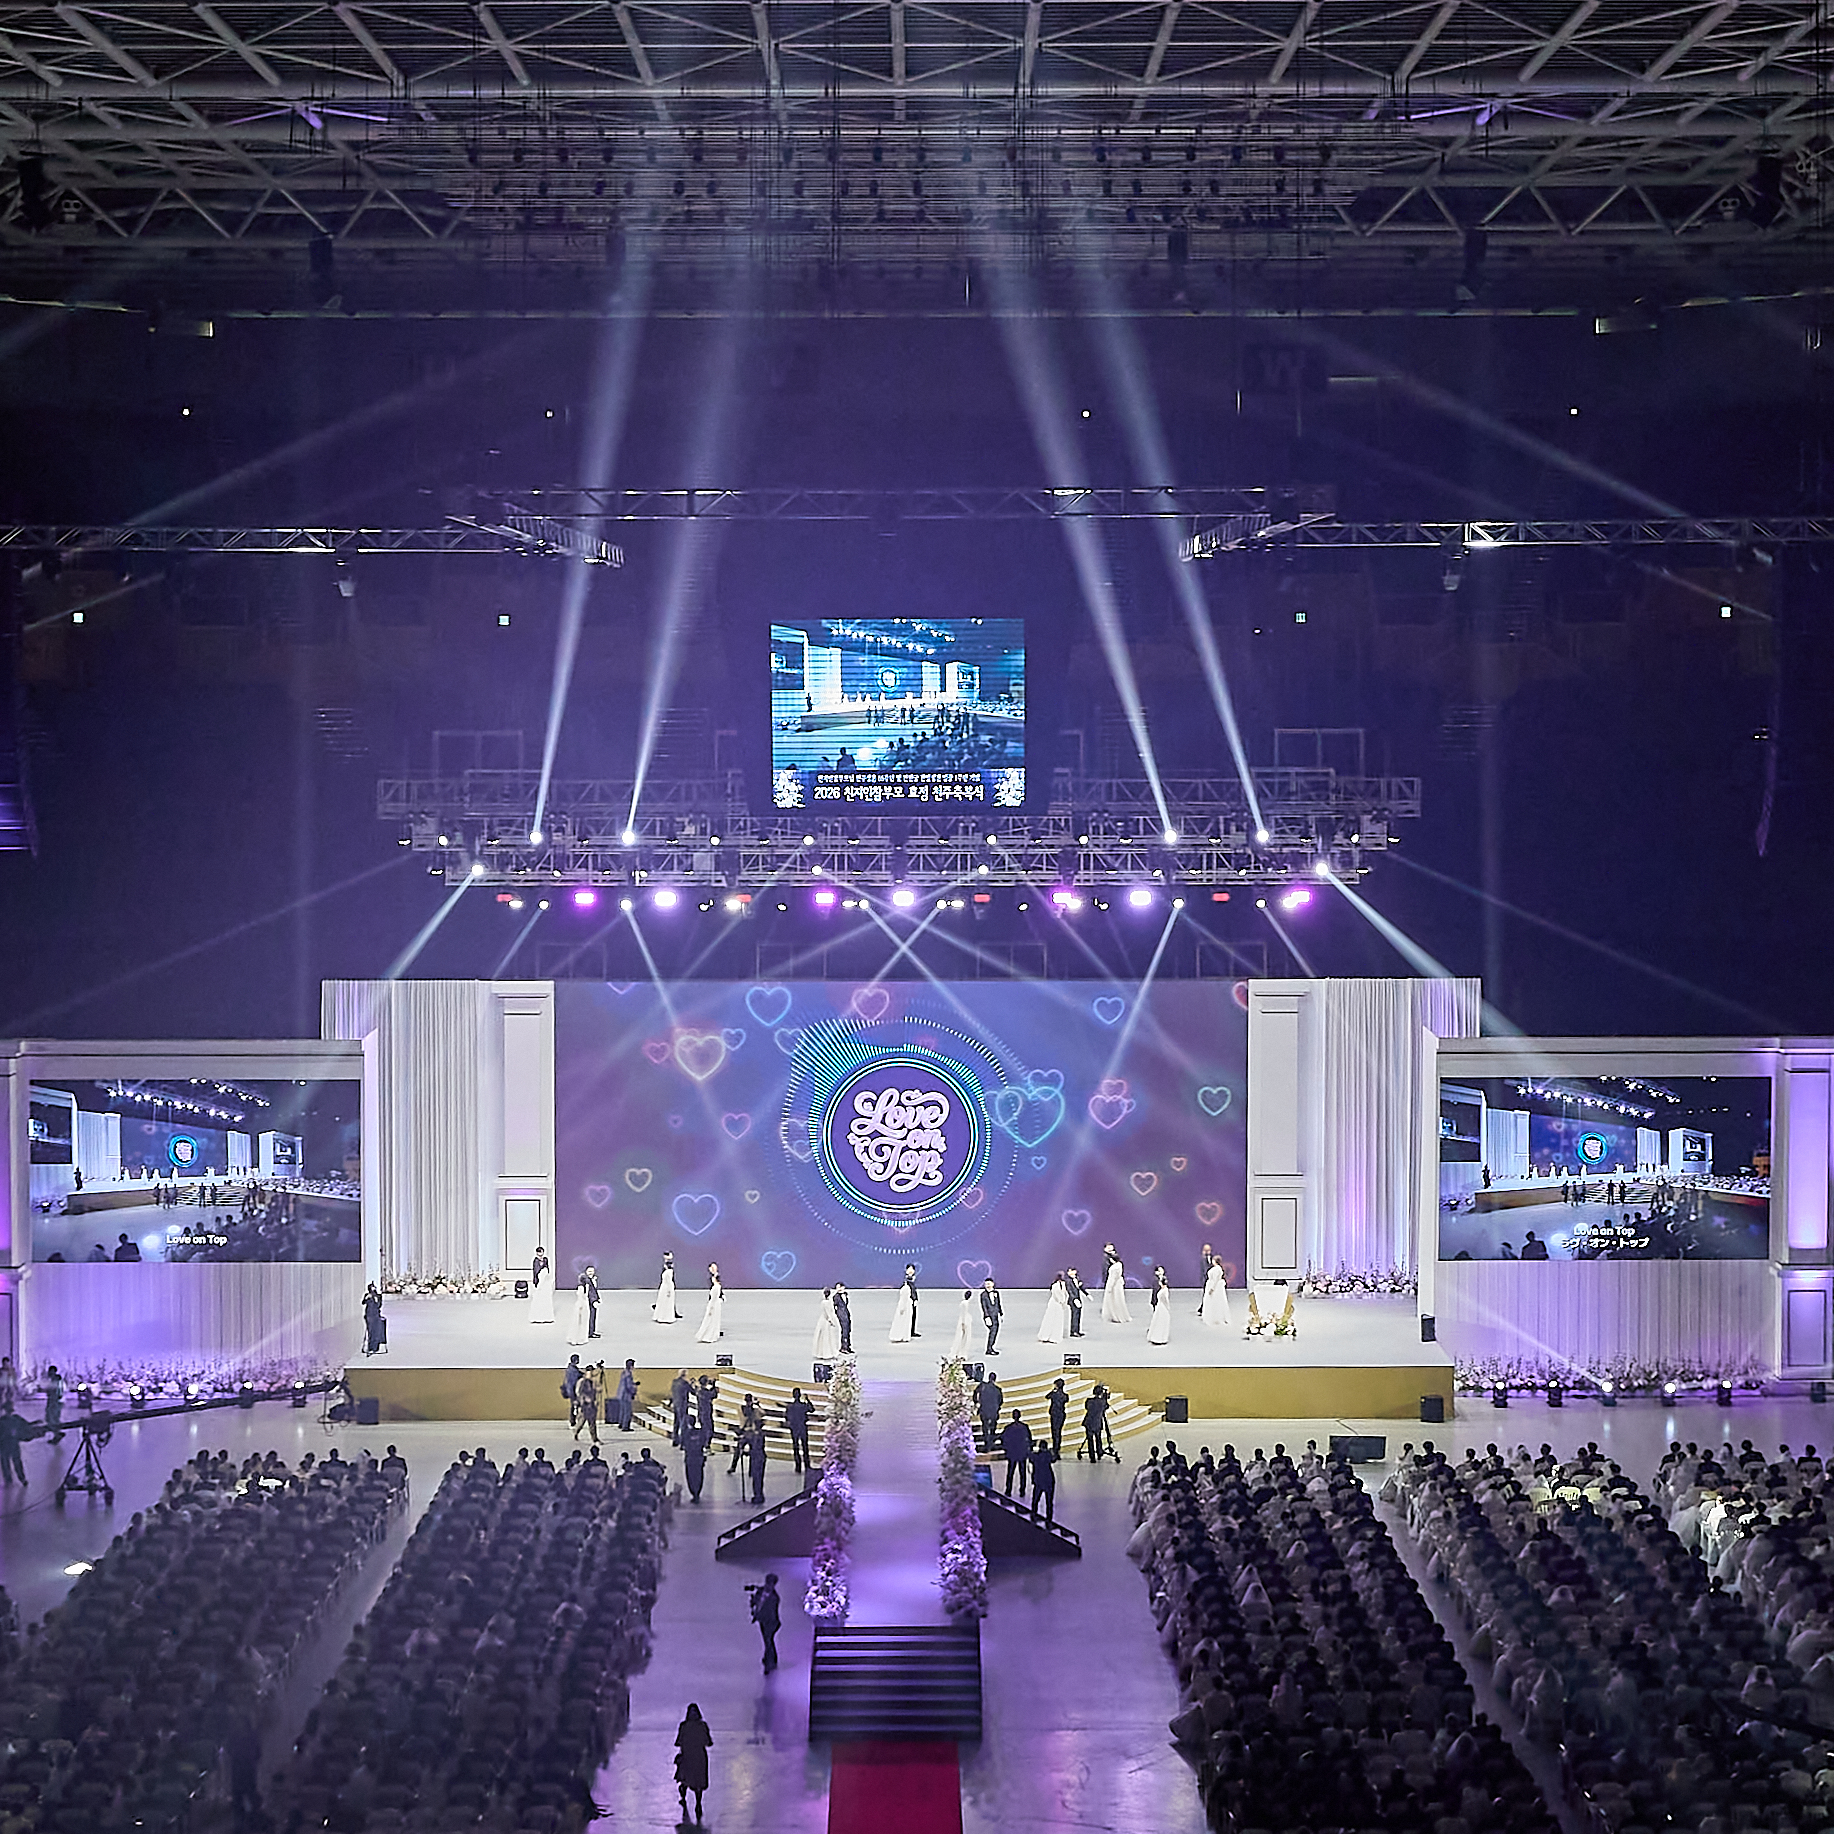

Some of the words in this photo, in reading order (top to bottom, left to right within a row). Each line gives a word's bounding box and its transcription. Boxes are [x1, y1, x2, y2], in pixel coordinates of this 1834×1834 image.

[814, 786, 841, 800] 2026
[850, 1087, 950, 1139] Love
[906, 1128, 947, 1153] on
[864, 1136, 944, 1193] Top
[166, 1234, 191, 1244] Love
[192, 1235, 207, 1244] on
[207, 1234, 228, 1247] Top
[1614, 1226, 1636, 1238] Top
